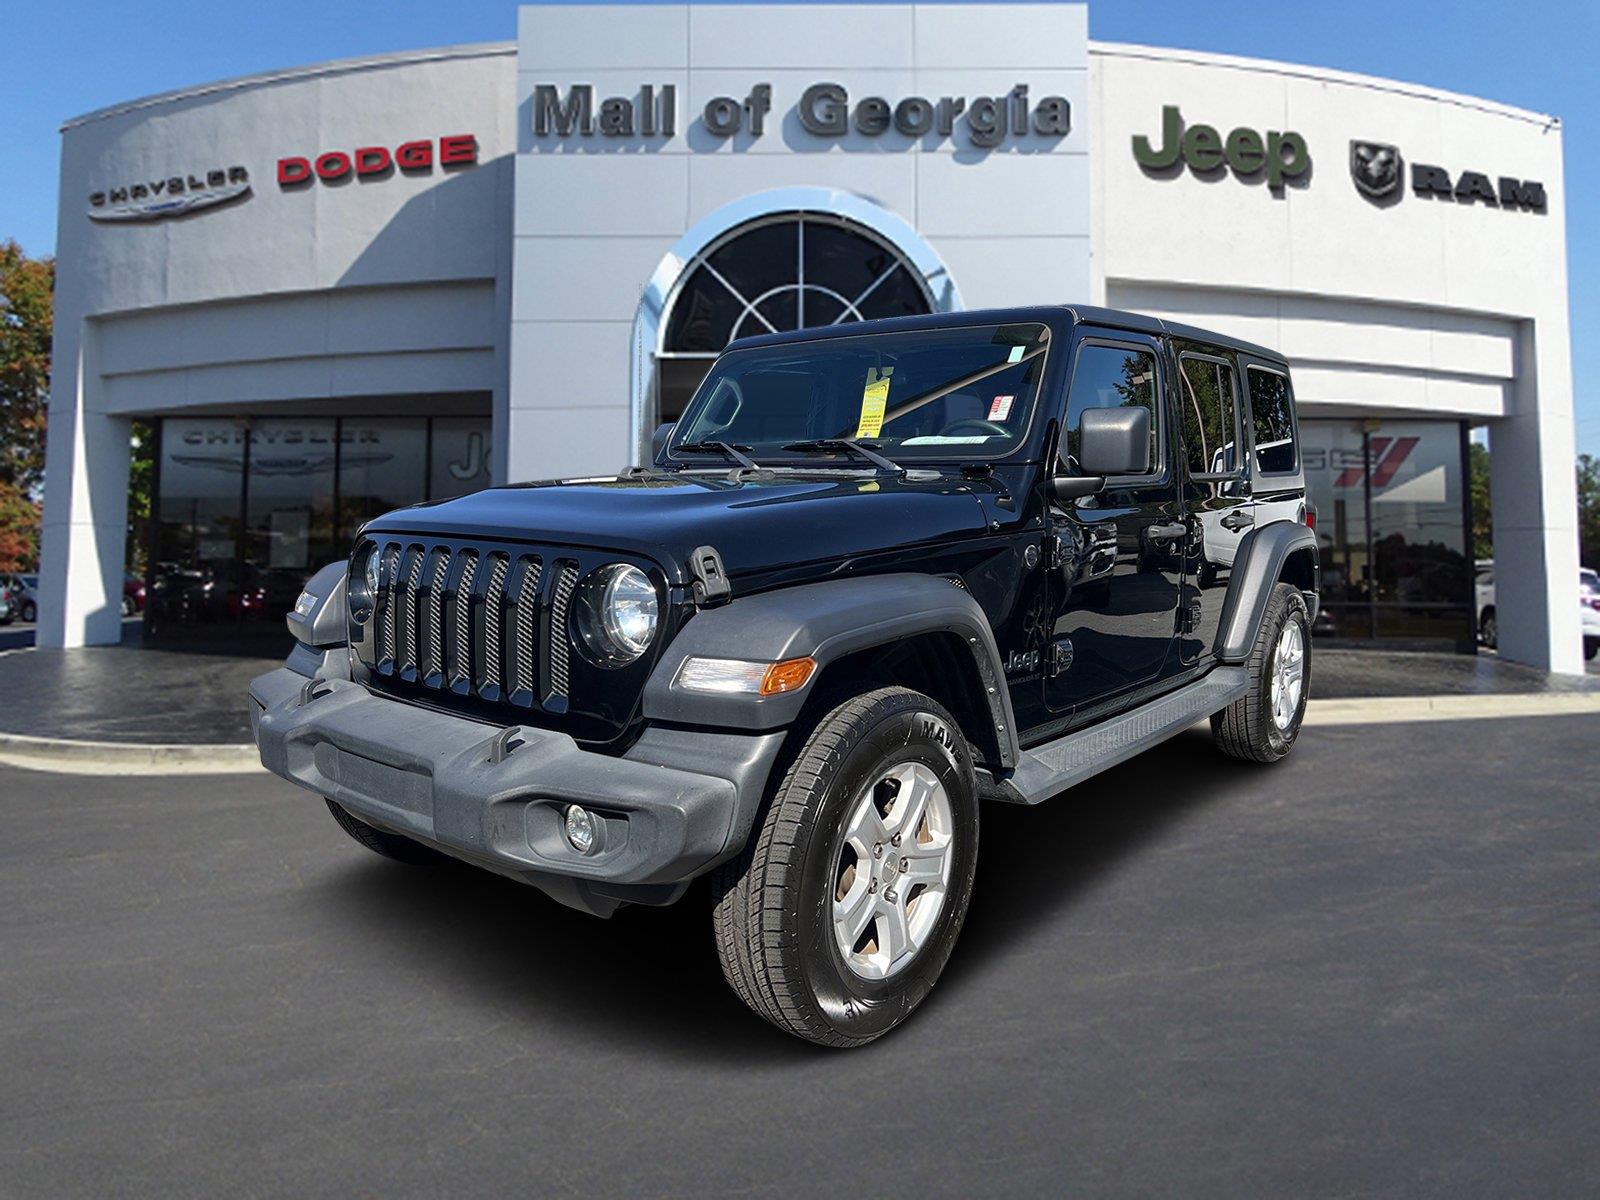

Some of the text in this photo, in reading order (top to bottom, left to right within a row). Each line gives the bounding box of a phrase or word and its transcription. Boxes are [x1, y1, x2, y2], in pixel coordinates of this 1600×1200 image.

[533, 83, 1071, 148] Mall of Georgia
[277, 134, 476, 184] DODGE
[1131, 105, 1309, 187] Jeep
[89, 166, 249, 207] CHRYSLER
[1411, 163, 1547, 209] RAM
[183, 430, 380, 445] CHRYSLER
[1003, 650, 1039, 673] Jeep
